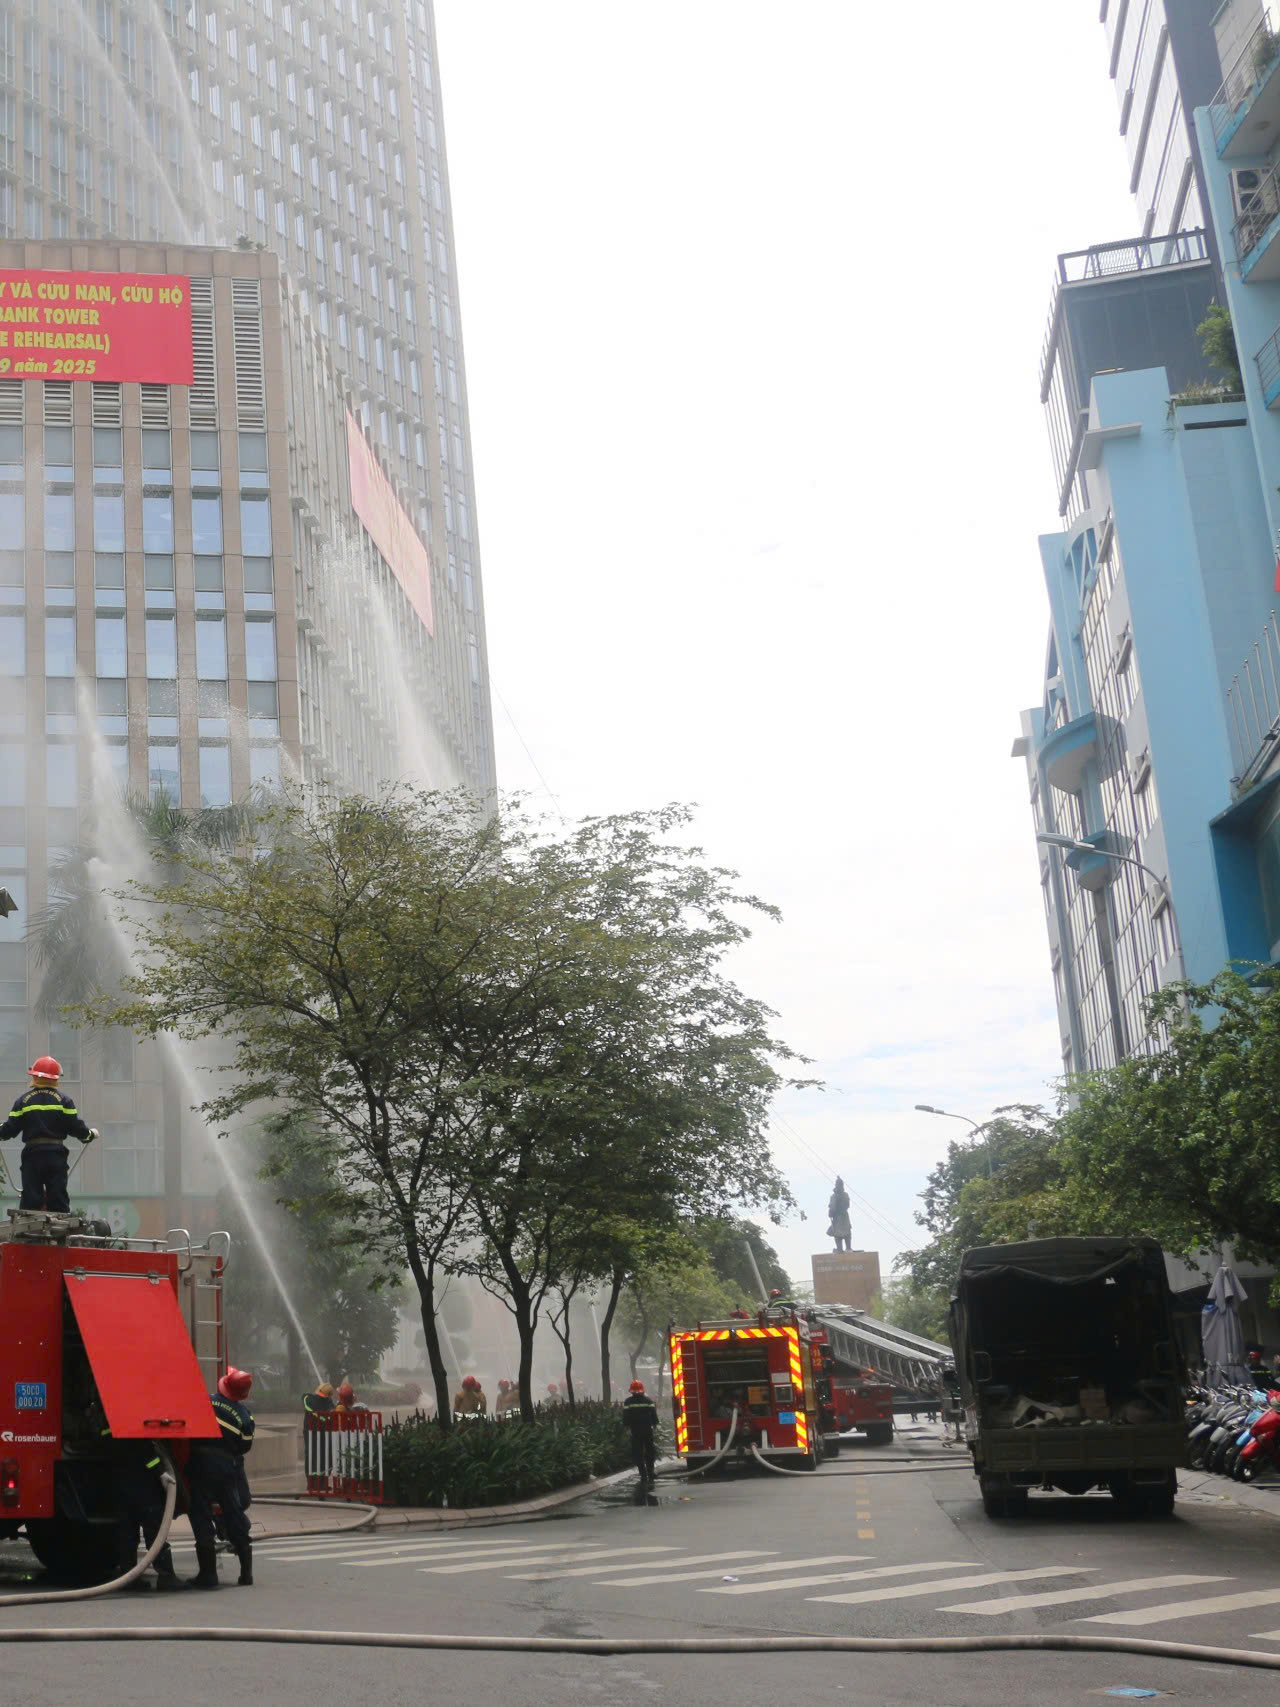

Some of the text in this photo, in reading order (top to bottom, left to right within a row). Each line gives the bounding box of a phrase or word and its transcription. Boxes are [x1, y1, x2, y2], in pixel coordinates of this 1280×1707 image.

[10, 280, 32, 298] VÀ
[37, 281, 69, 300] CỨU
[75, 284, 116, 305] NẠN,
[122, 283, 153, 303] CỨU
[159, 285, 183, 308] HỘ
[44, 307, 100, 325] TOWER
[14, 331, 111, 354] REHEARSAL)
[0, 357, 11, 373] 9
[14, 357, 48, 373] năm
[52, 359, 96, 374] 2025
[14, 1433, 57, 1442] rosenbauer
